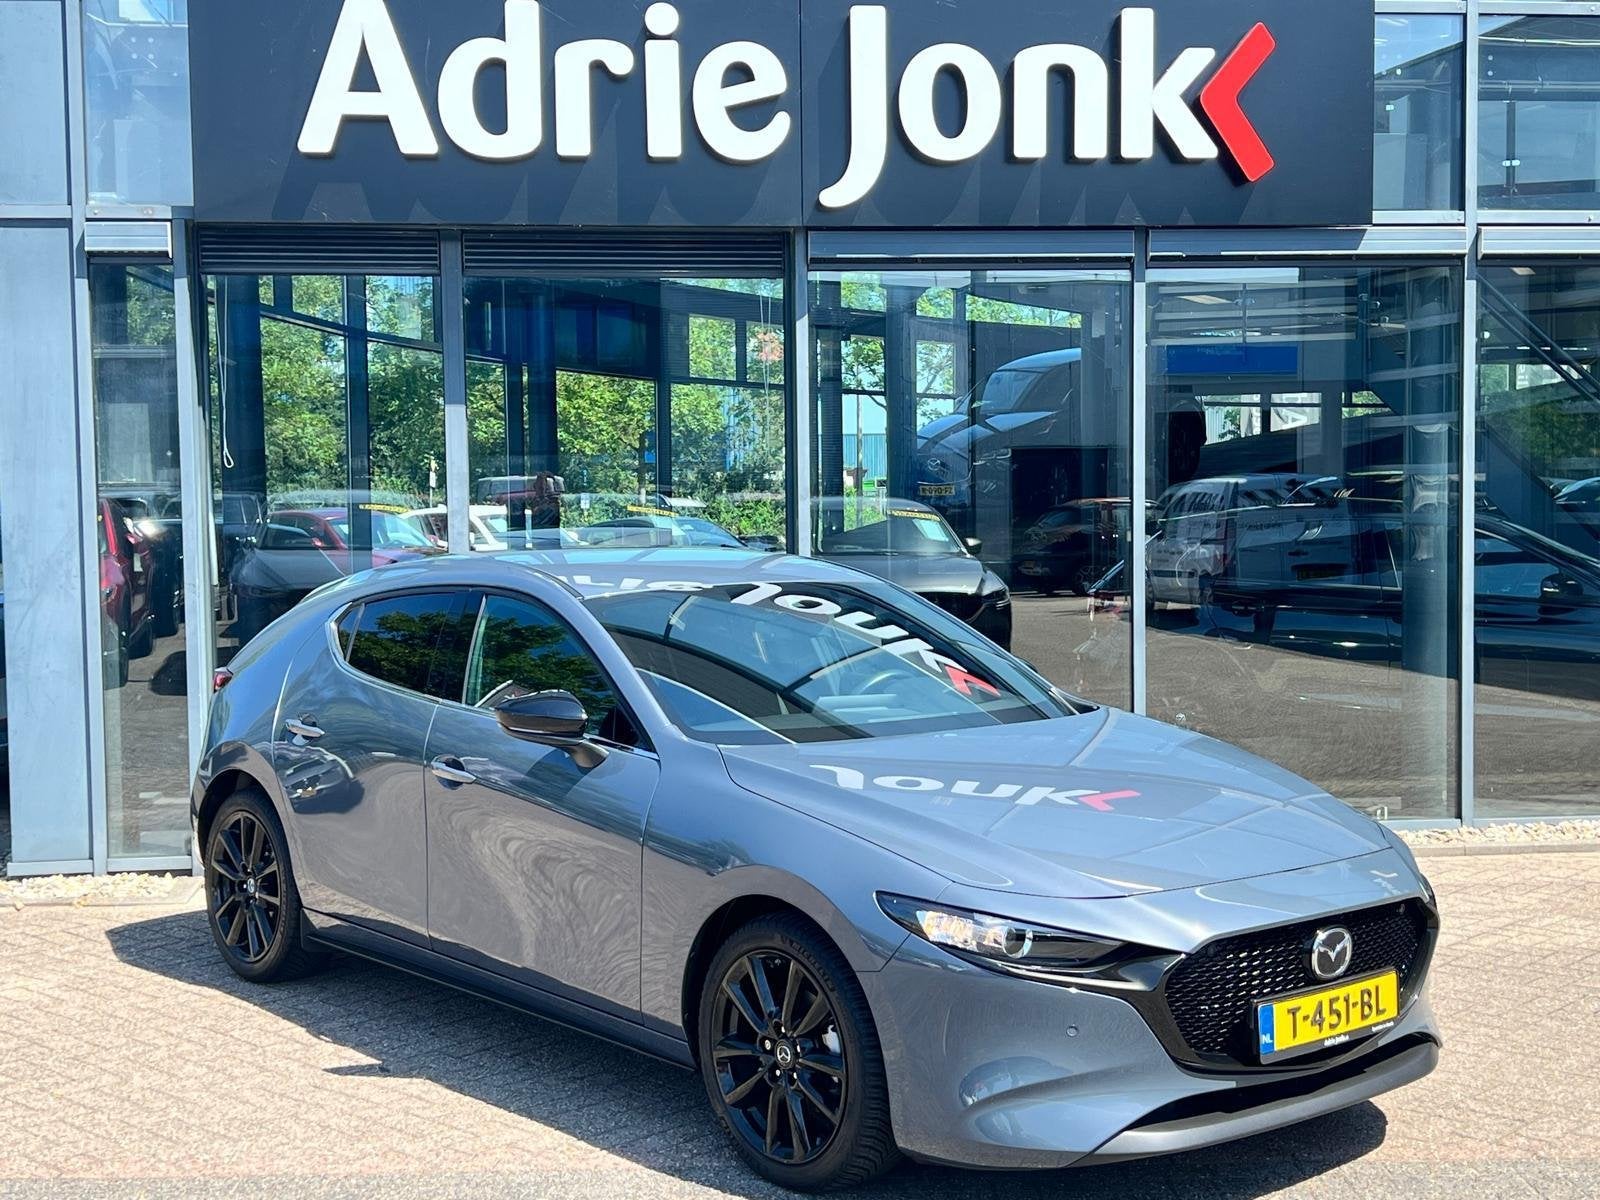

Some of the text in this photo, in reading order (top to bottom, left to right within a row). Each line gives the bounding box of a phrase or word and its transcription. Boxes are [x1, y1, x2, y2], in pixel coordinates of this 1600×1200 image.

[297, 0, 1219, 208] Adrie Jonk
[1261, 1033, 1273, 1044] NL
[1287, 985, 1386, 1039] T-451-BL
